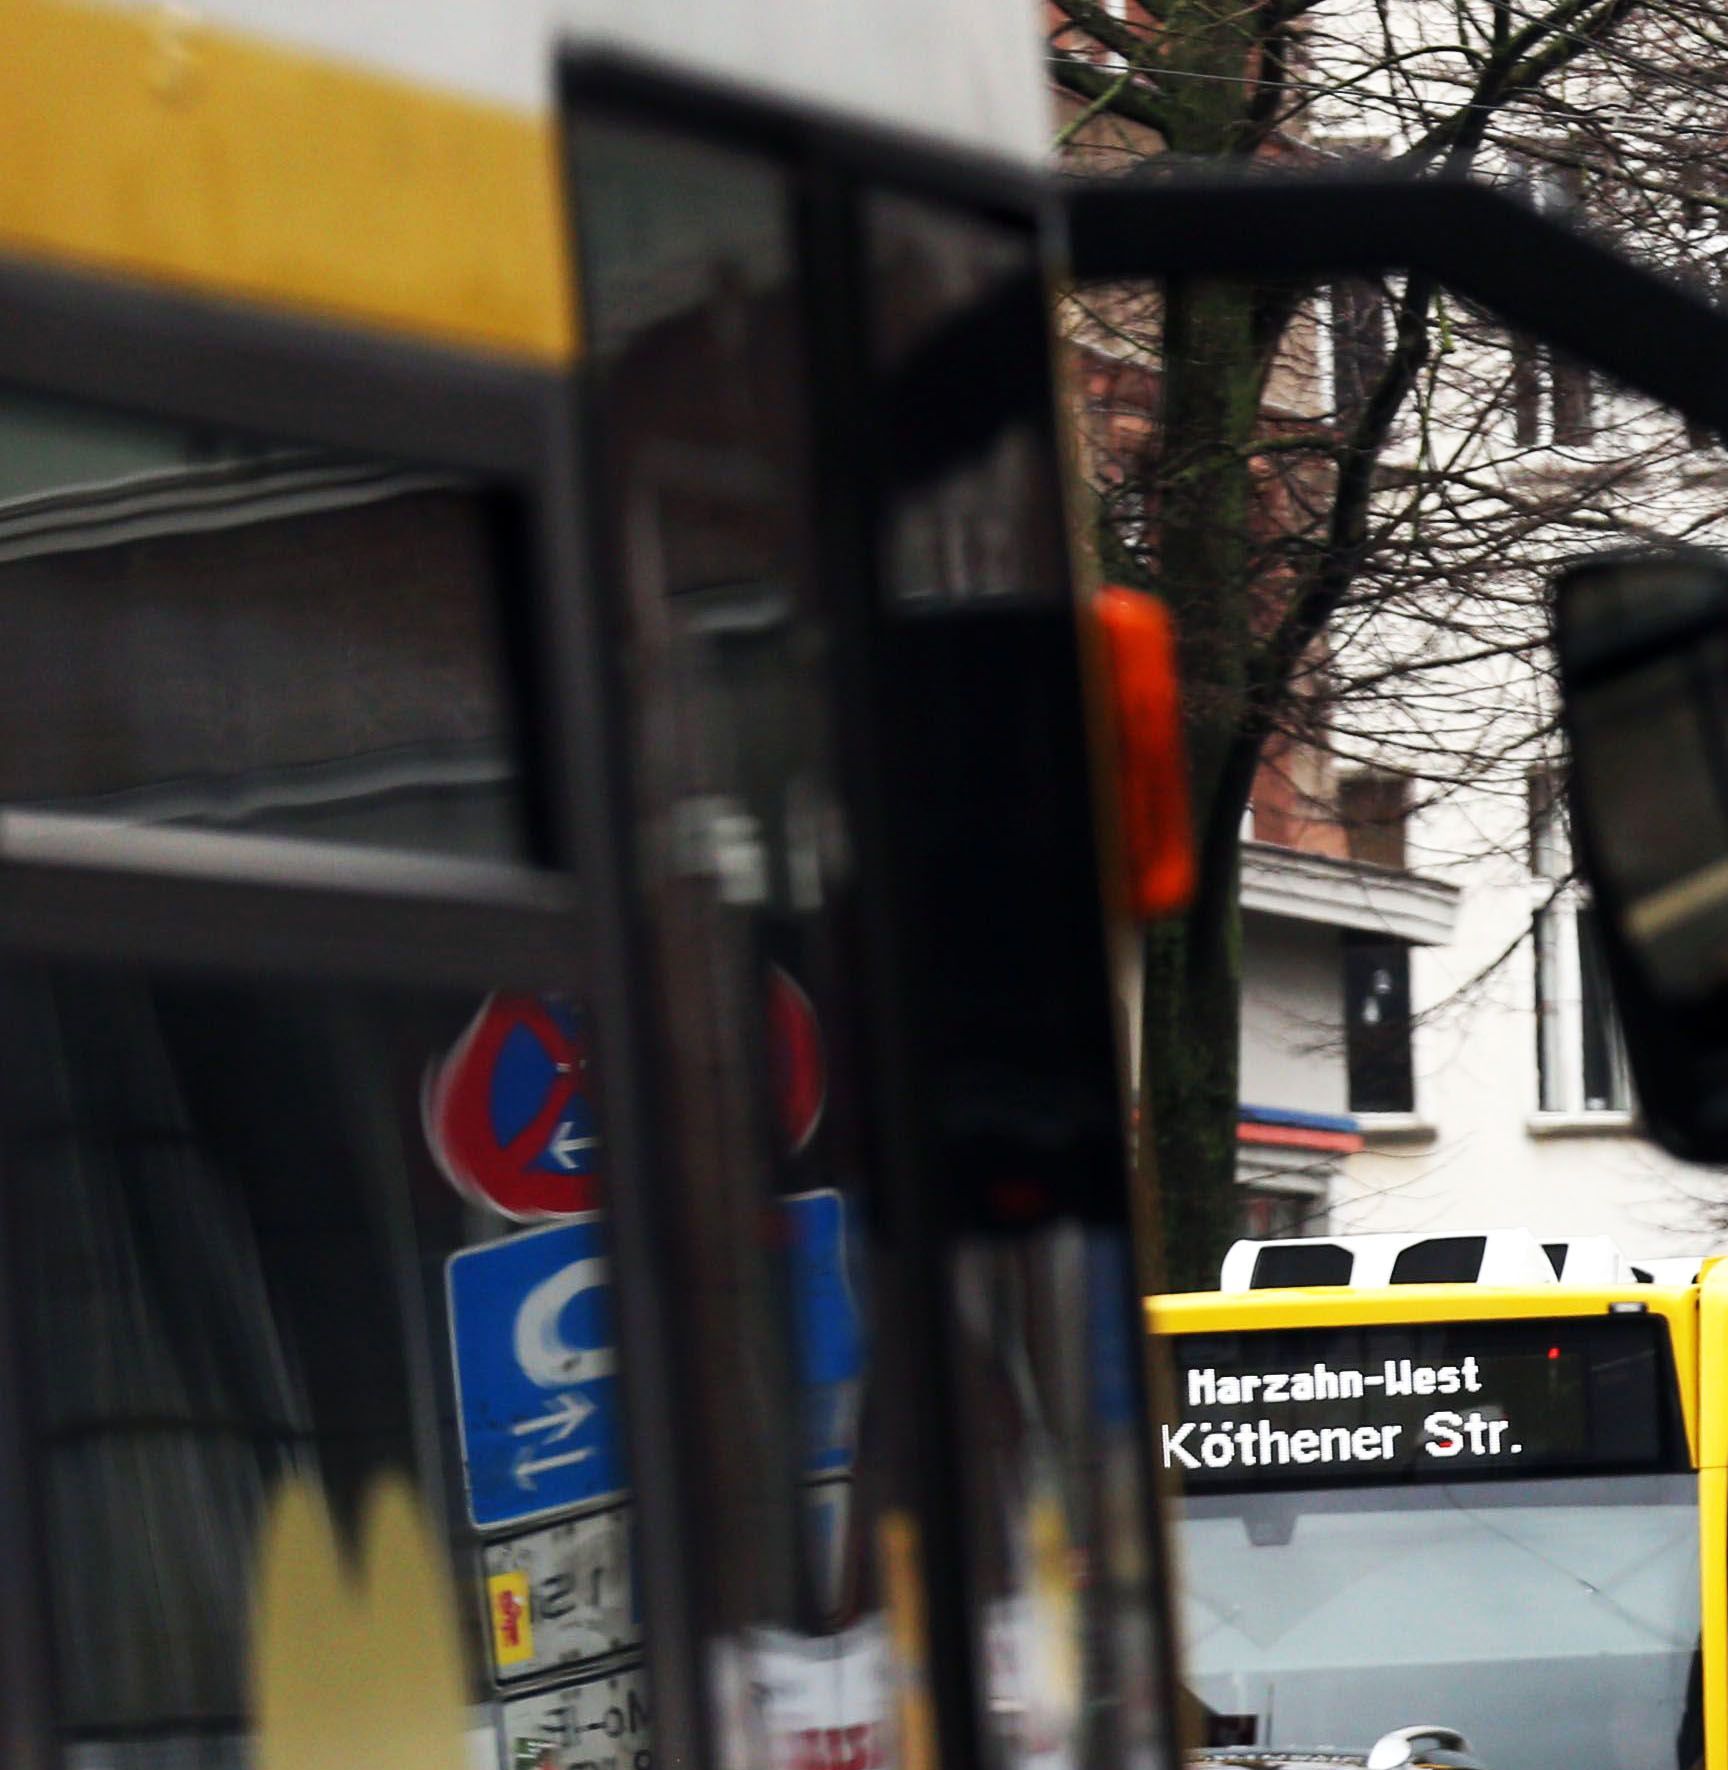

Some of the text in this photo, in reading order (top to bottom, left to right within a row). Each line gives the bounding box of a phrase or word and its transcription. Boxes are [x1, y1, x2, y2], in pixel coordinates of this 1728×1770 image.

[1187, 1356, 1482, 1406] Marzahn-West
[1161, 1410, 1522, 1469] Köthener Str.
